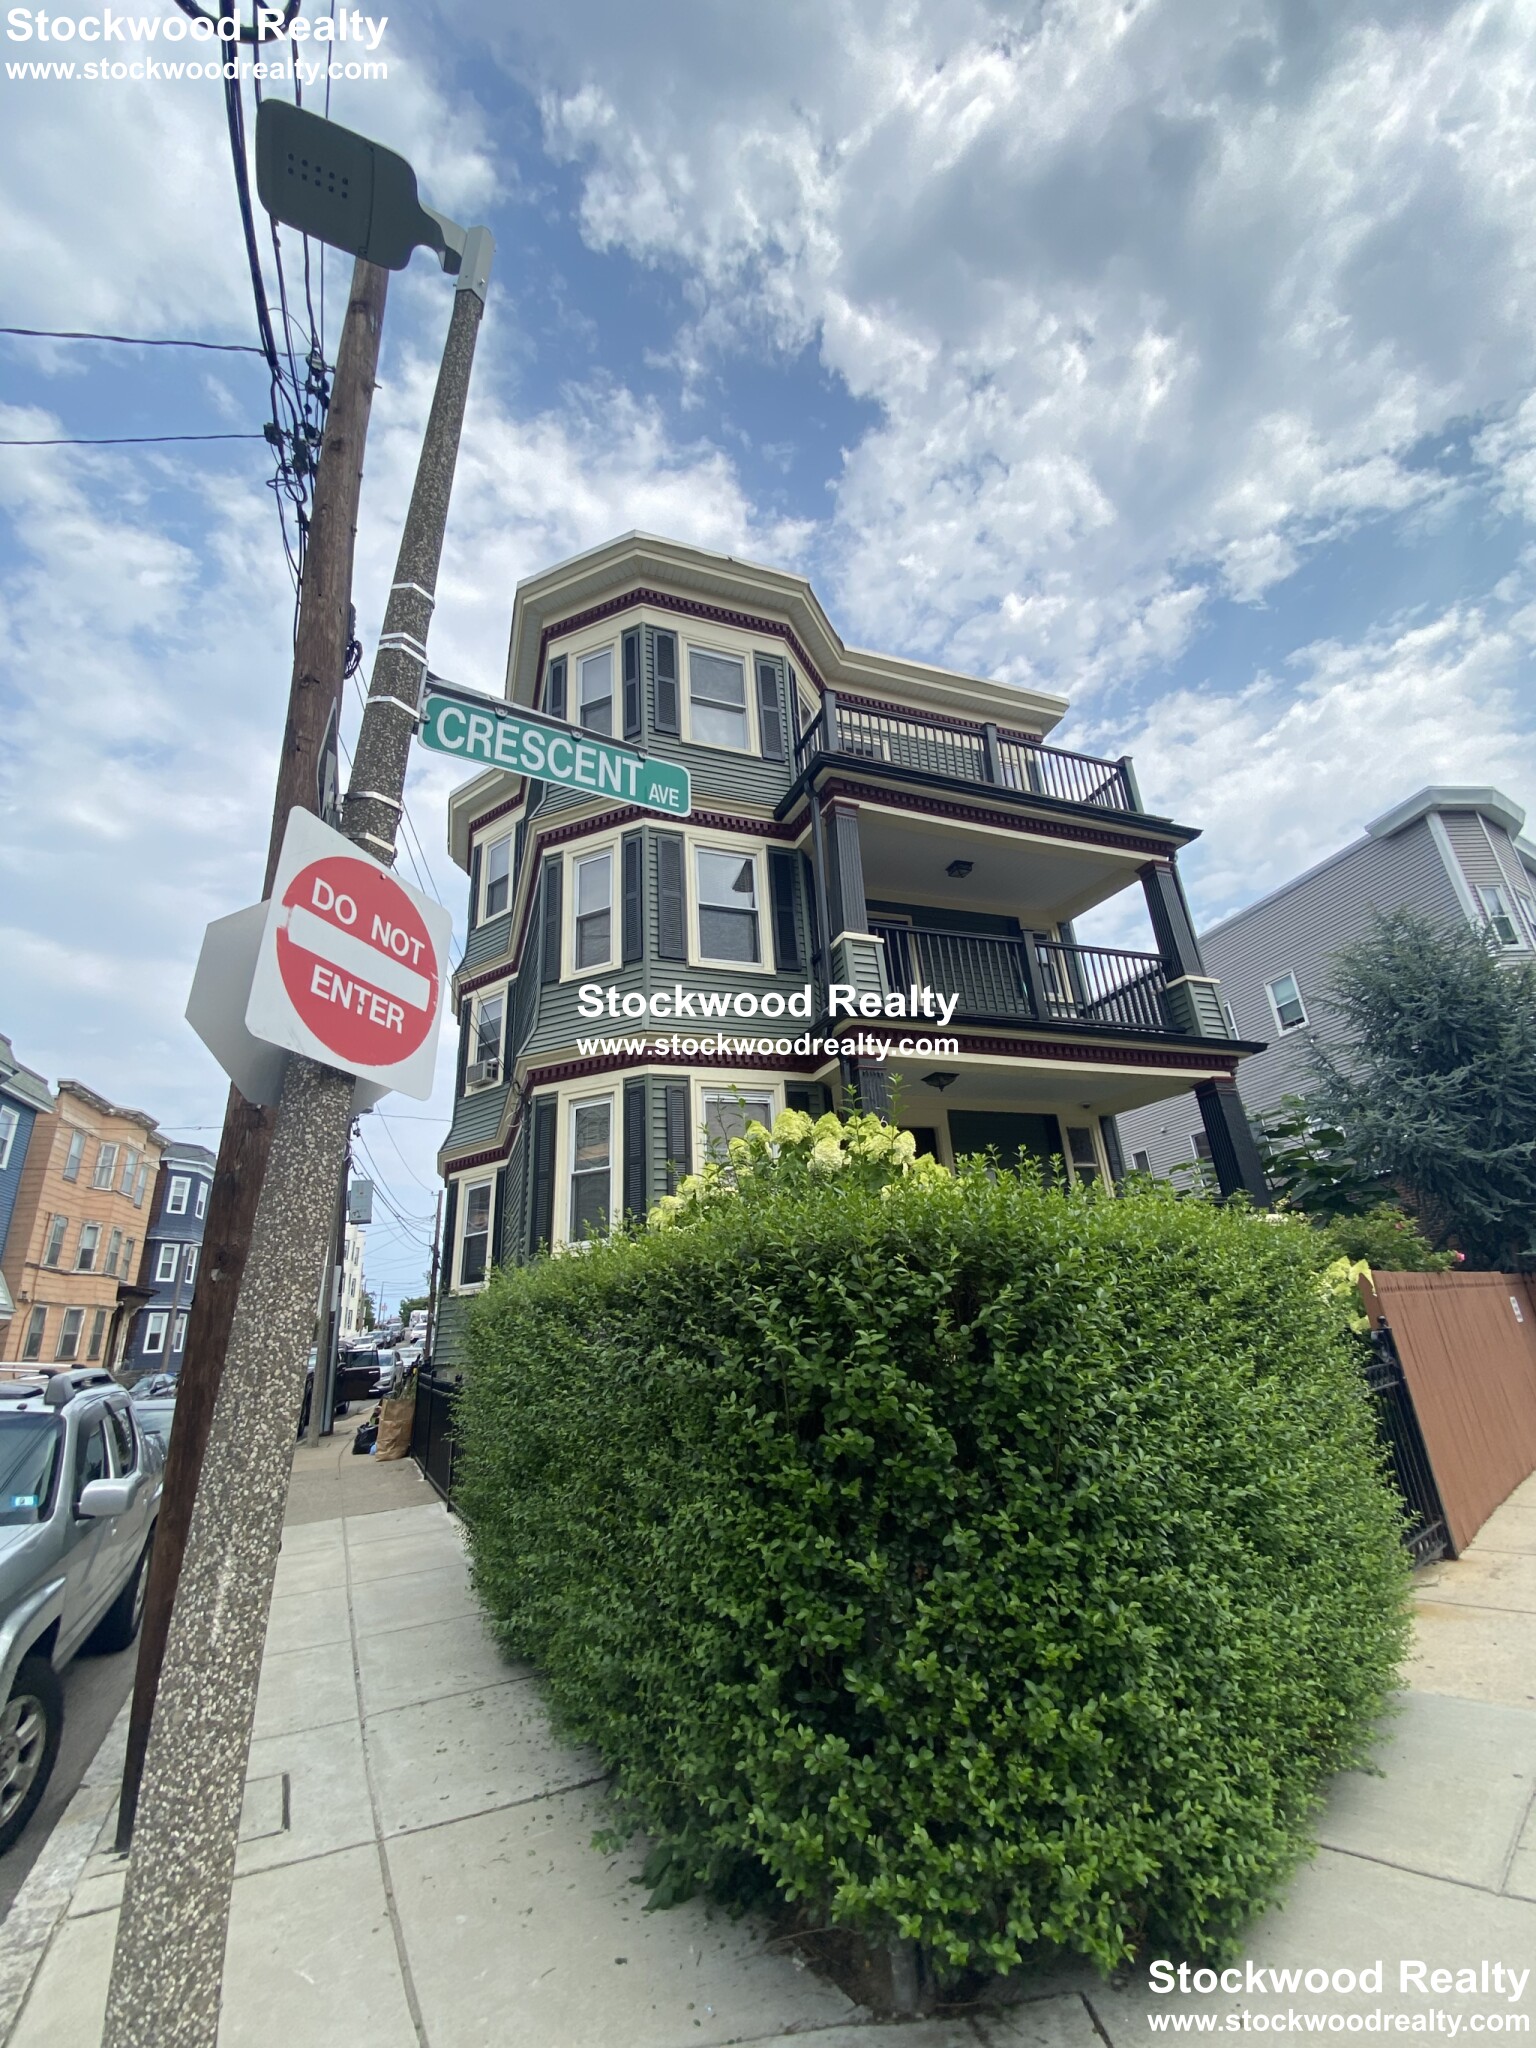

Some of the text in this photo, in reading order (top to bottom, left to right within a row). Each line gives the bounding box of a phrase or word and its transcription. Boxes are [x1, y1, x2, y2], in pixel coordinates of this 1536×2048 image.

[436, 706, 680, 808] CRESCENT AVE
[311, 877, 426, 965] DO NOT
[310, 964, 405, 1034] ENTER
